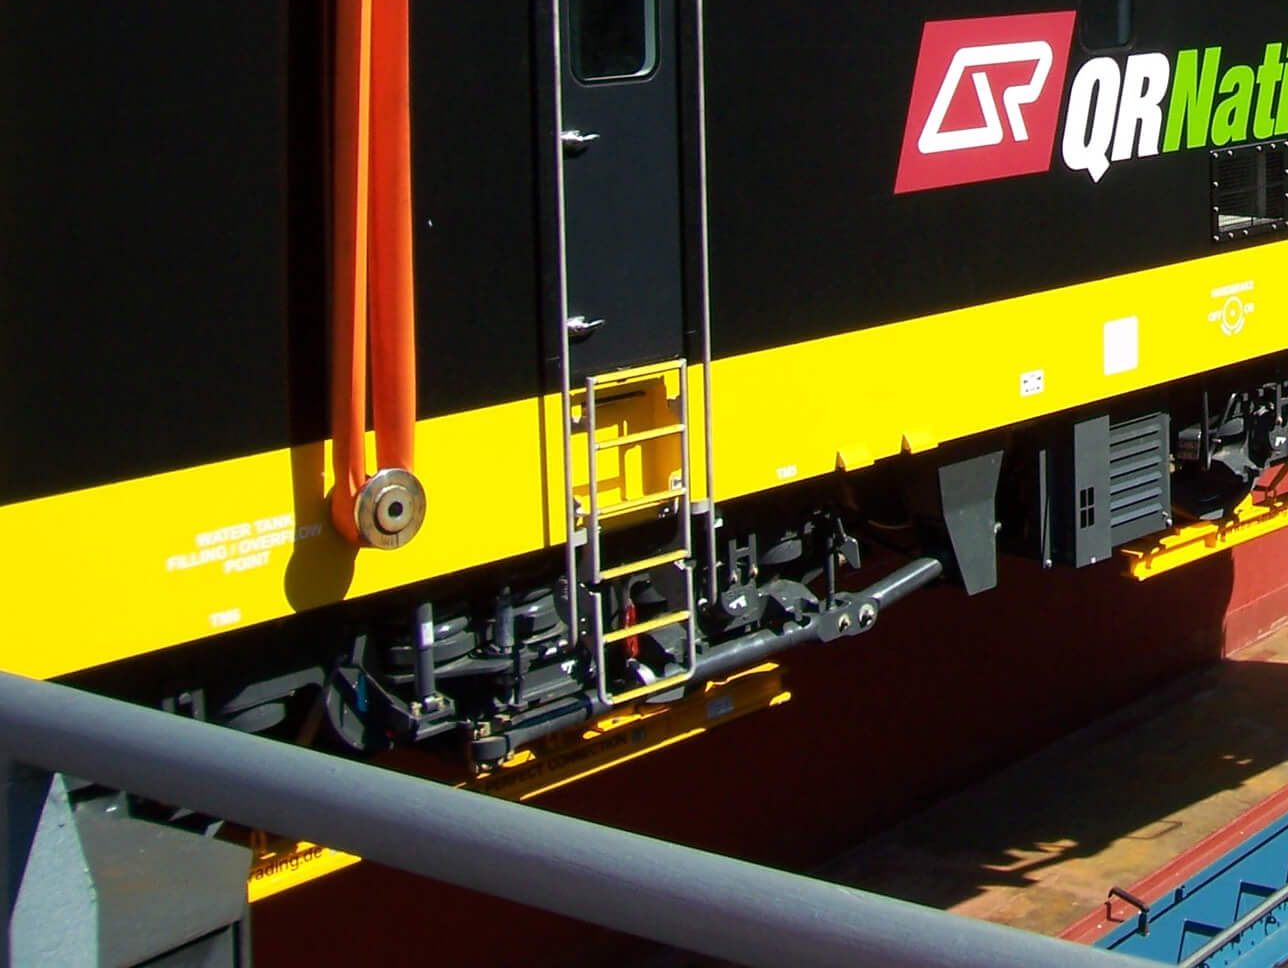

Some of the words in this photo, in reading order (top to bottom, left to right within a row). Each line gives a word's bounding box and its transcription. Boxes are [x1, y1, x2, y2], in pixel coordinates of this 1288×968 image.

[165, 544, 227, 572] FILLING
[238, 523, 322, 555] OVERFLOW
[194, 522, 251, 548] WATER
[253, 513, 294, 535] TANK
[222, 550, 270, 575] POINT
[249, 844, 322, 881] rading.de
